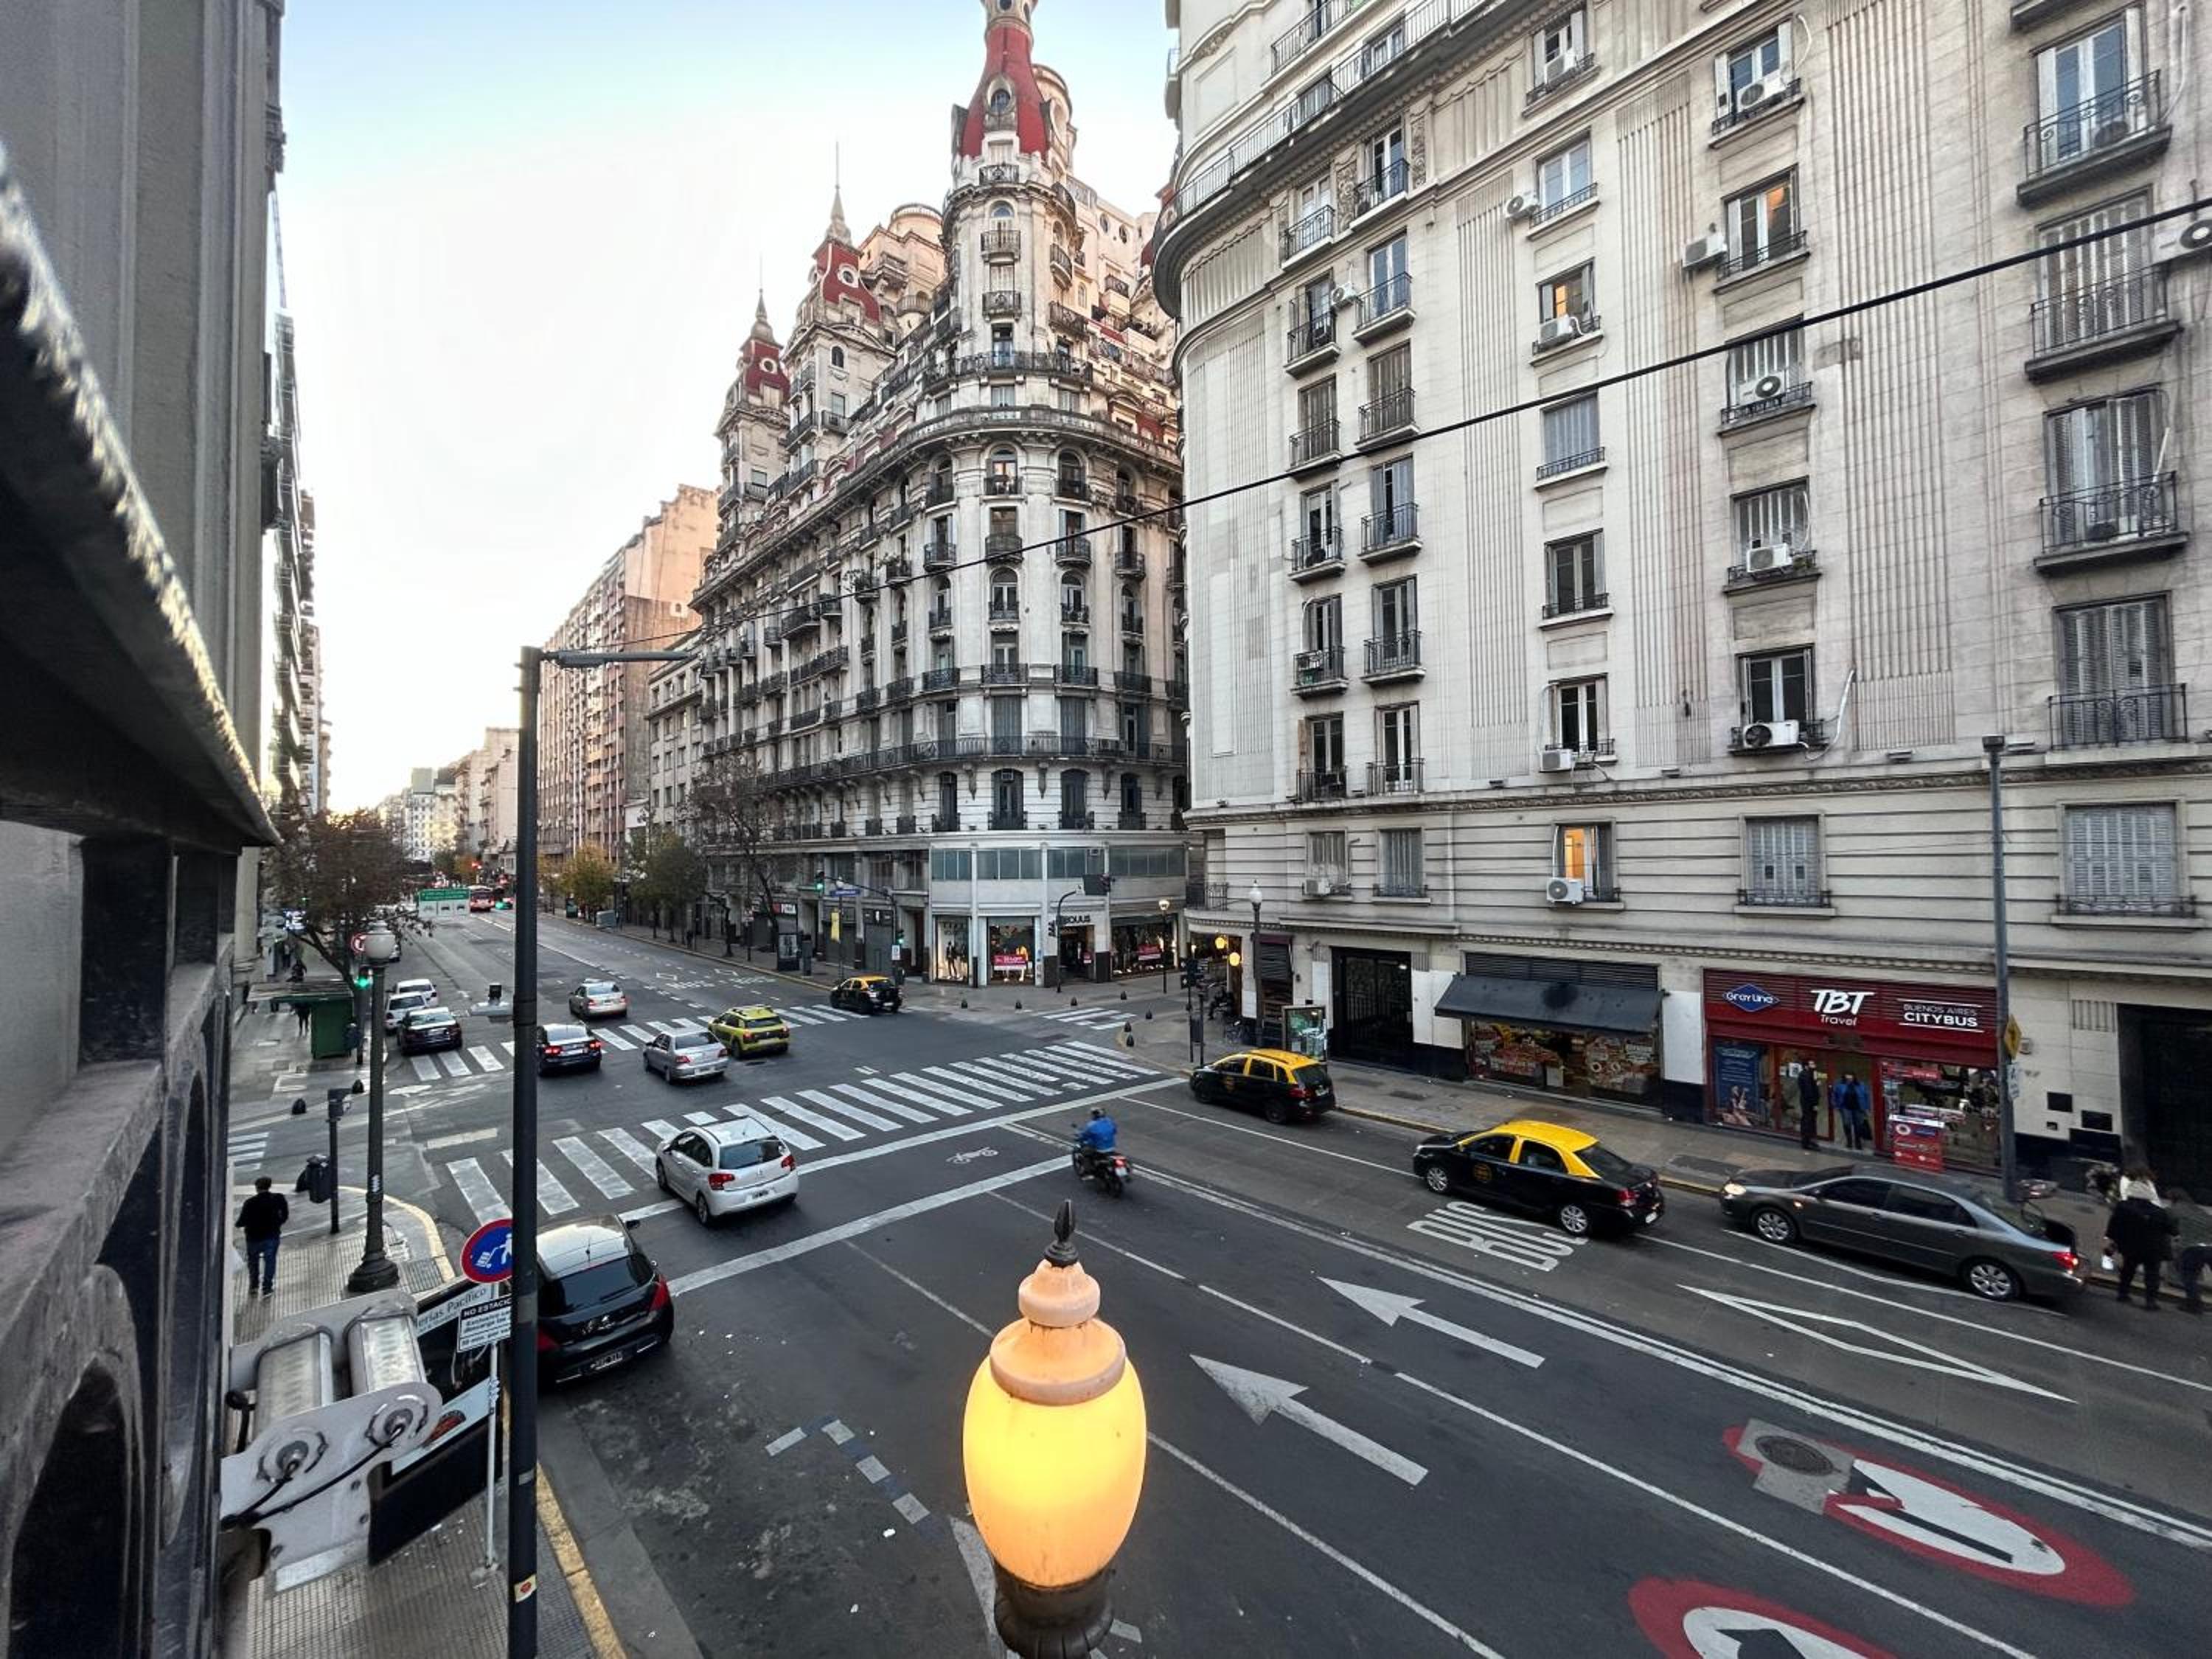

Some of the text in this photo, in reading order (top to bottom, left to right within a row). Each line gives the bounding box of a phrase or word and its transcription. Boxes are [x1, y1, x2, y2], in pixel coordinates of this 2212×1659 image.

[1810, 990, 1875, 1015] TBT
[1903, 1004, 1978, 1016] BUENOS AIRES
[1820, 1015, 1857, 1026] Travel
[1904, 1012, 1978, 1027] CITYBUS
[464, 1309, 476, 1317] NO
